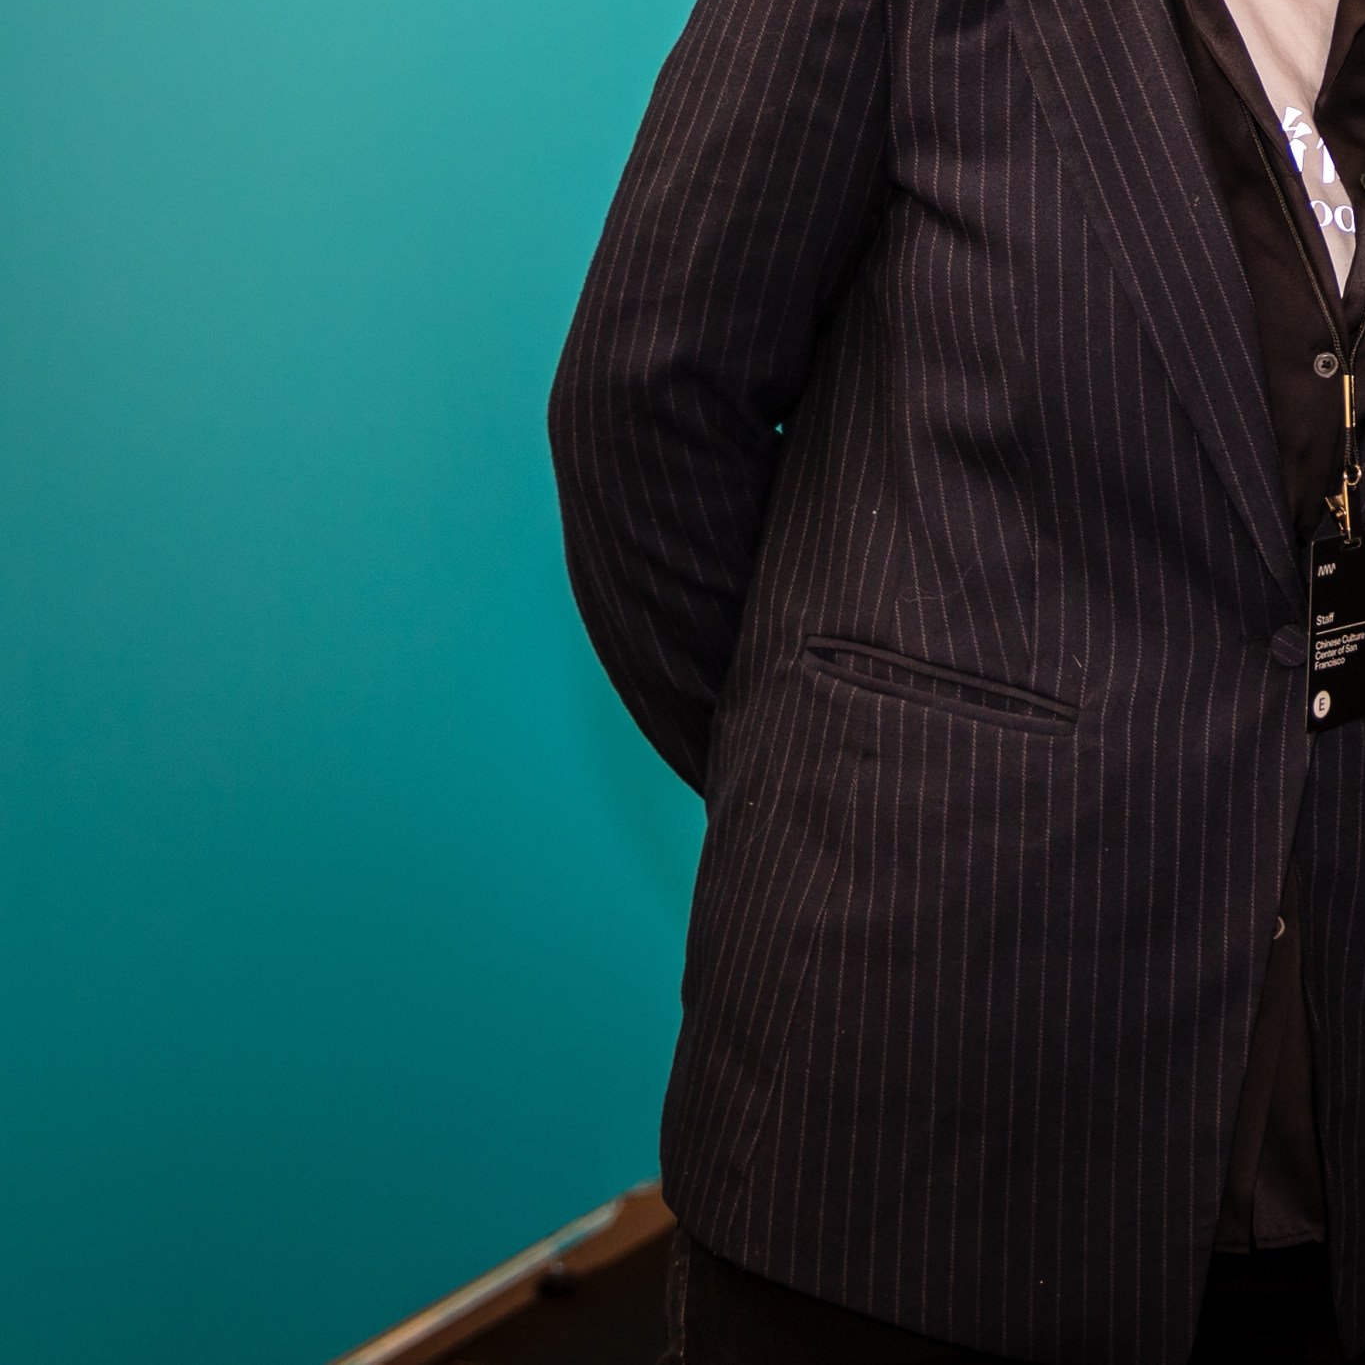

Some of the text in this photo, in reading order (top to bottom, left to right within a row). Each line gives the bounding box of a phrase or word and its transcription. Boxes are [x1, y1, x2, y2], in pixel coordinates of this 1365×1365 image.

[1316, 612, 1335, 626] Staff
[1315, 632, 1365, 651] Chinese Culture
[1315, 643, 1358, 661] Center of San
[1314, 657, 1346, 671] Francisco
[1318, 697, 1326, 711] E
